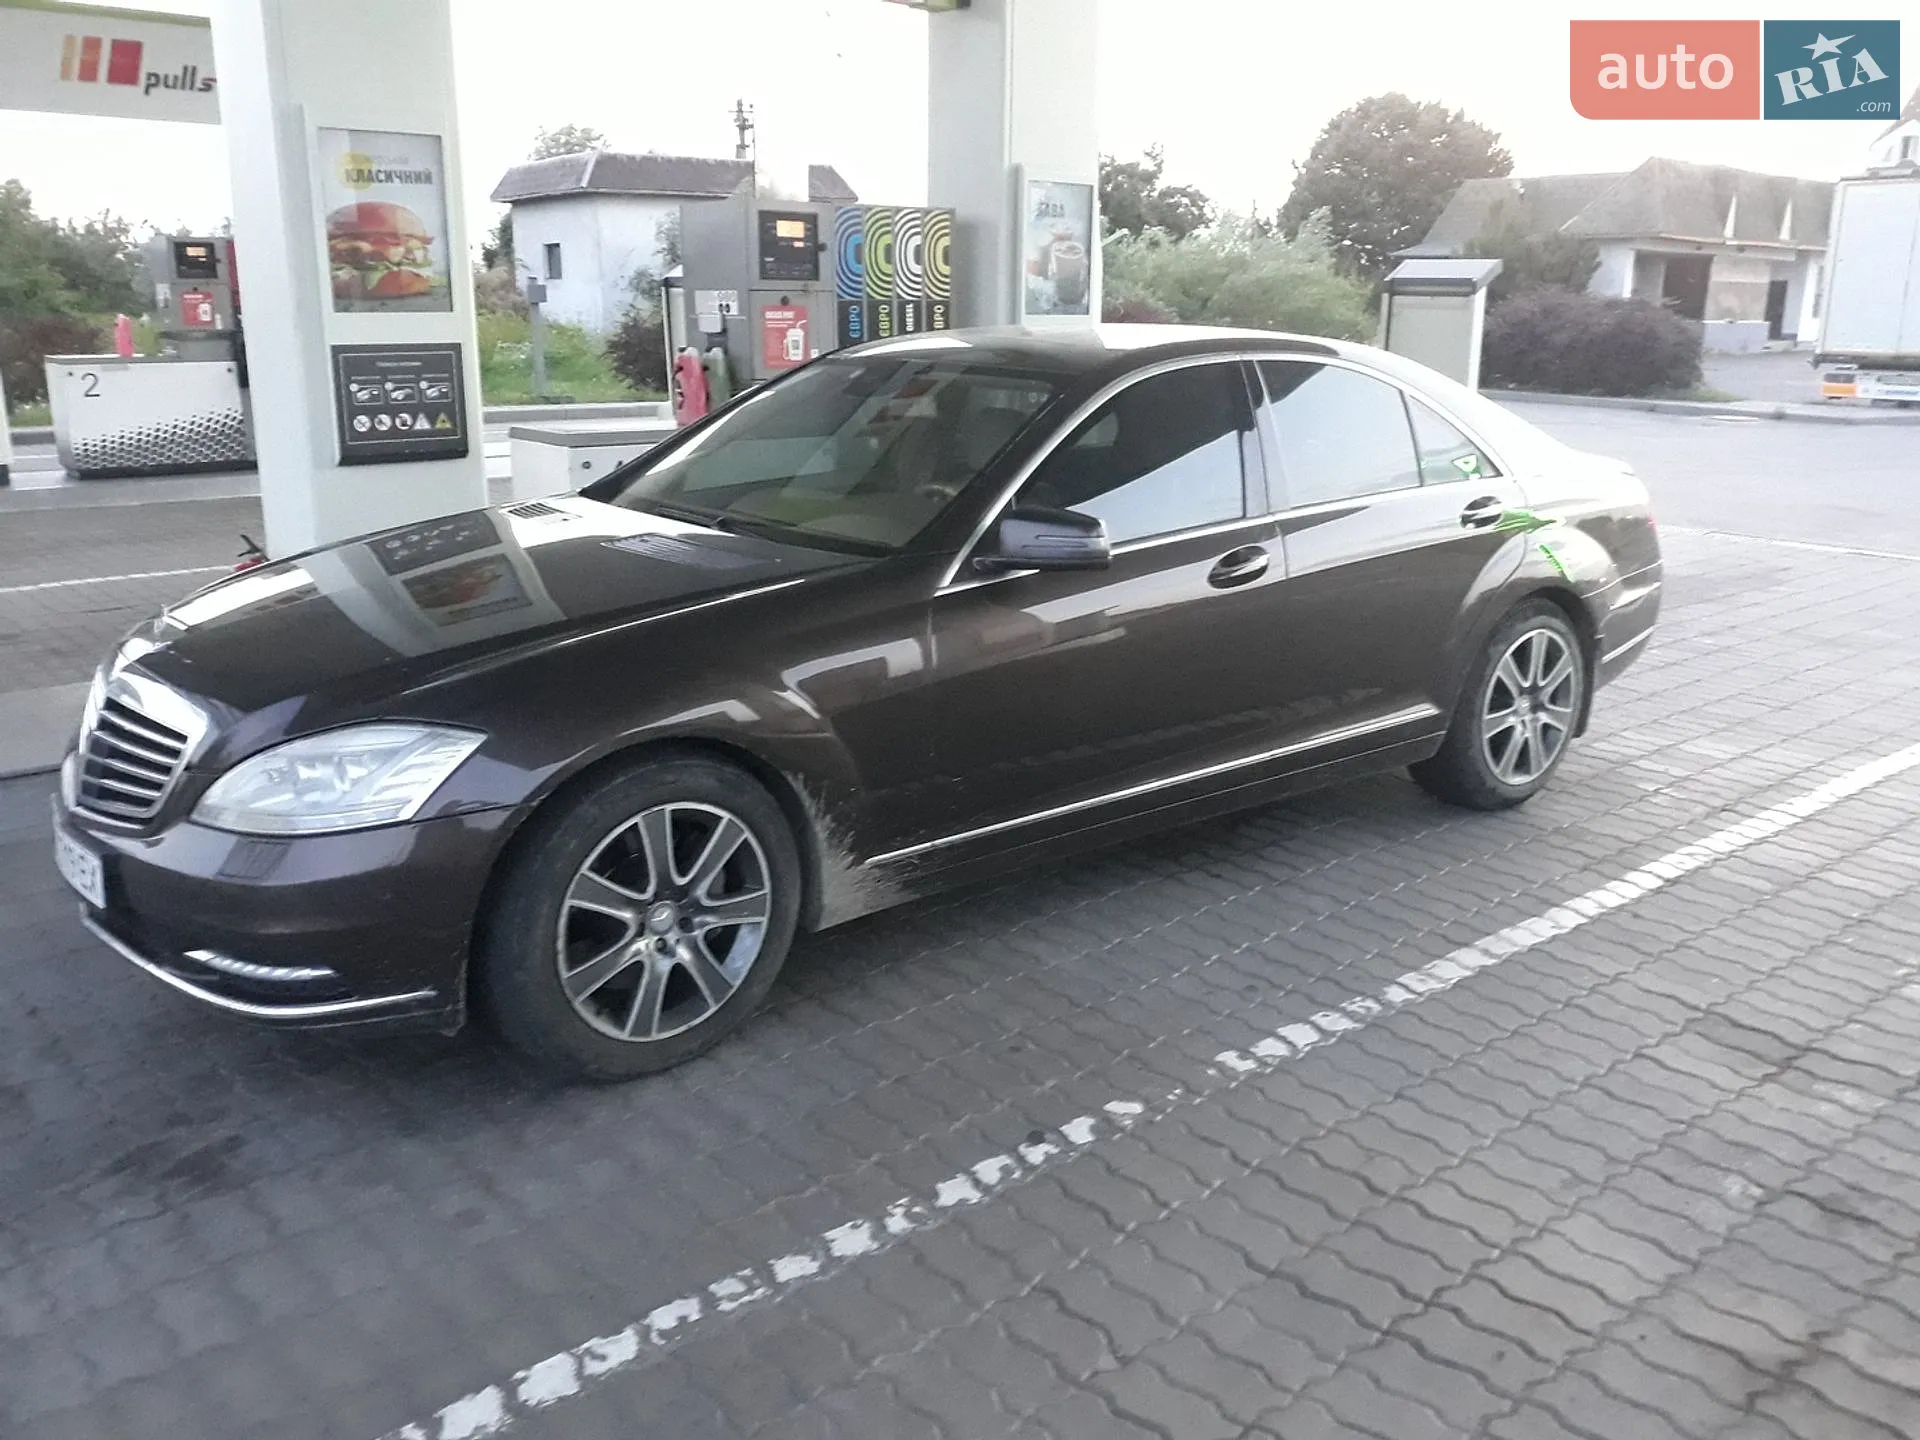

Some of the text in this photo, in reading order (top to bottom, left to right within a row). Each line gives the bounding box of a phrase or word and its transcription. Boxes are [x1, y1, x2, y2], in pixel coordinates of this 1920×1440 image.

[144, 64, 217, 96] pulls
[343, 166, 433, 185] КЛАСИЧНИЙ
[81, 372, 100, 397] 2
